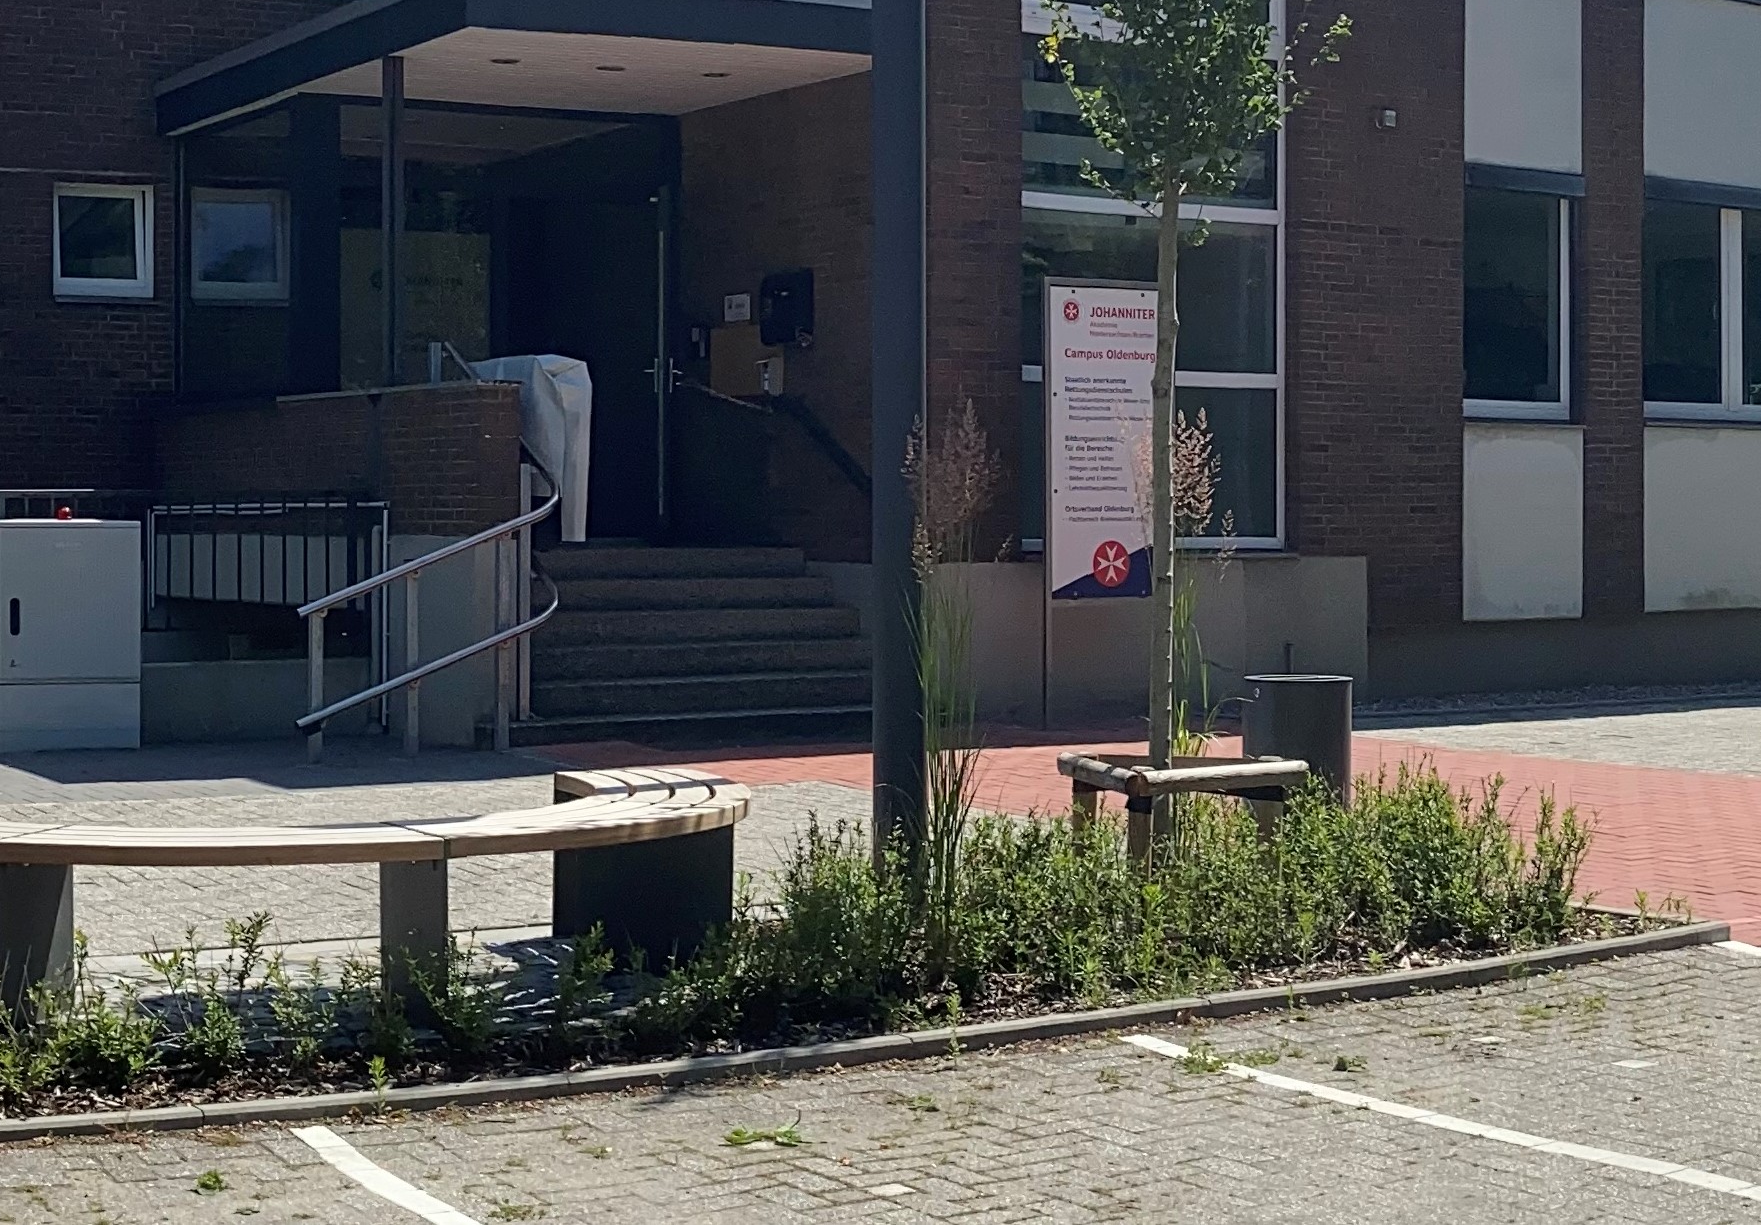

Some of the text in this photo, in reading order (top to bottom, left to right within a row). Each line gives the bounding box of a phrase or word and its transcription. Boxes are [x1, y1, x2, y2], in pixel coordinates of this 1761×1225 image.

[1089, 307, 1155, 320] JOHANNITER
[1064, 347, 1155, 363] Campus Oldenburg
